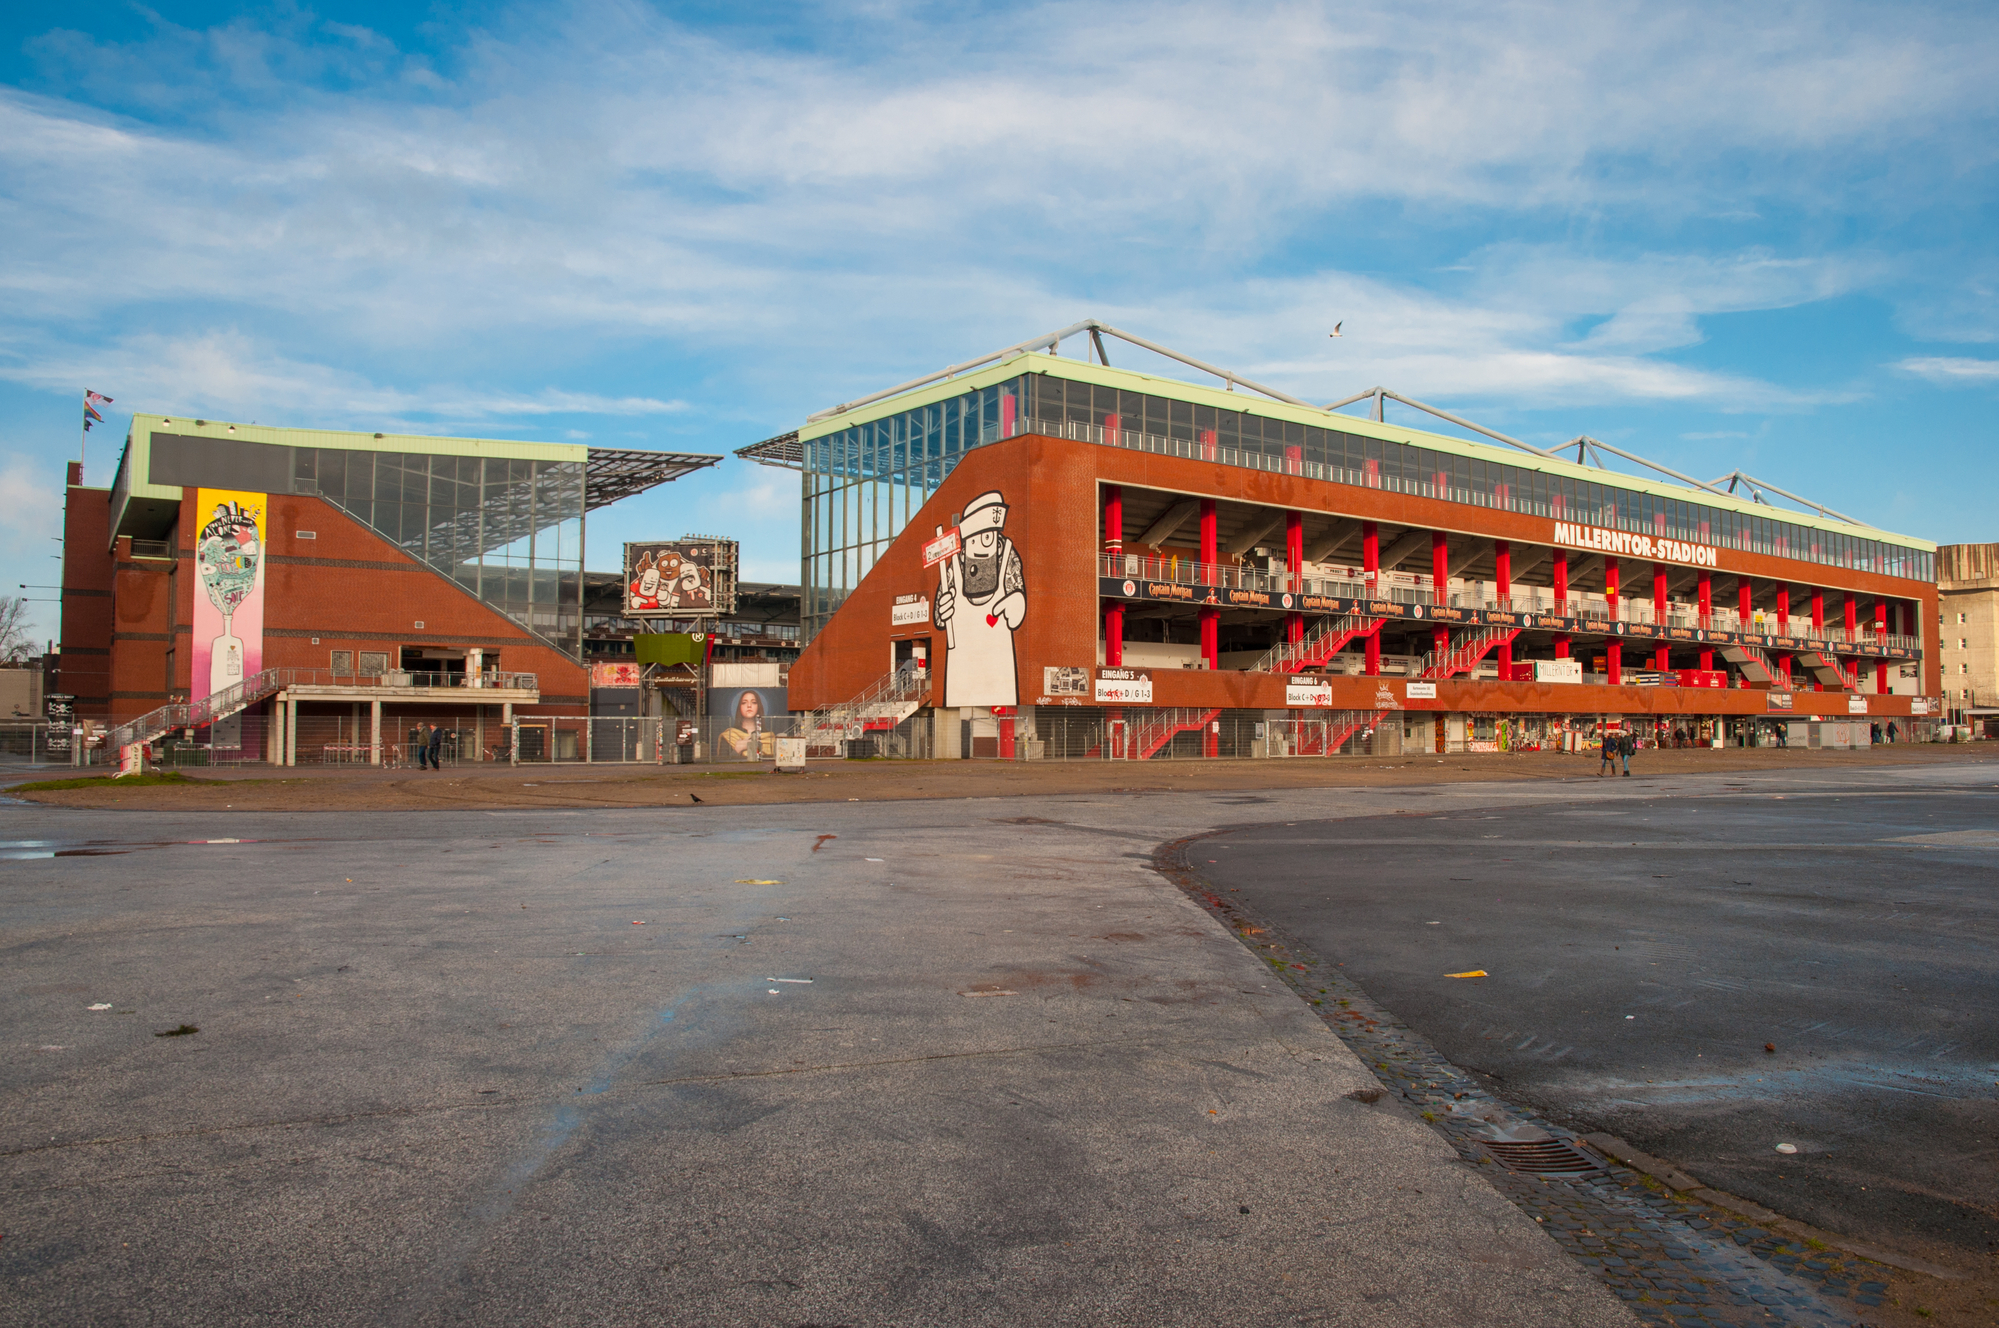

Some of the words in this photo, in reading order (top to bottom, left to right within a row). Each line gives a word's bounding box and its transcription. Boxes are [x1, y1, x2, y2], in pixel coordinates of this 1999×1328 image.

[1554, 522, 1716, 567] MILLERNTOR-STADION
[1149, 582, 1170, 596] Captain
[1170, 583, 1193, 599] Morgan
[896, 594, 913, 604] EINGANG
[1229, 590, 1249, 602] Captain
[1248, 590, 1270, 605] Morgan
[1302, 596, 1321, 608] Captain
[1320, 596, 1340, 610] Morgan
[894, 613, 903, 621] Block
[1102, 670, 1129, 679] EINGANG
[1130, 671, 1134, 679] 5
[1539, 664, 1573, 677] MILLERNTOR
[1292, 676, 1313, 685] EINGANG
[1314, 677, 1318, 685] 6
